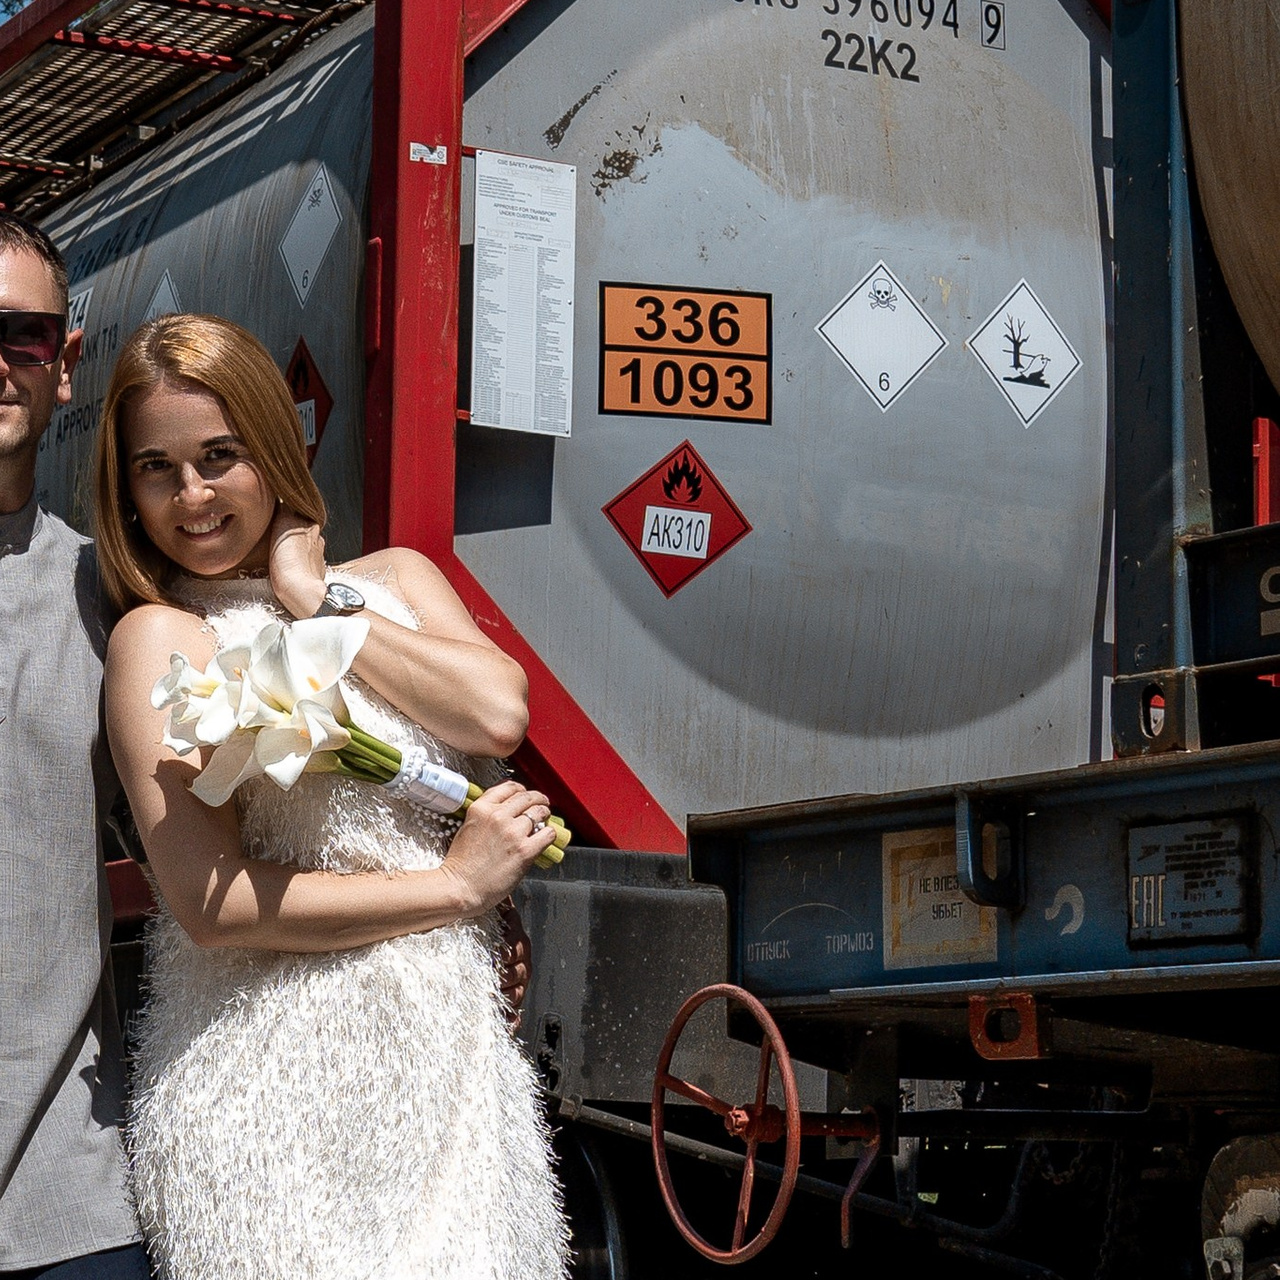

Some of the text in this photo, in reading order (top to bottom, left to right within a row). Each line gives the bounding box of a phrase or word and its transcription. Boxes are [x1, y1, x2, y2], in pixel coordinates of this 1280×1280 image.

[983, 4, 1002, 44] 9
[821, 29, 920, 83] 22K2
[302, 269, 309, 289] 6
[634, 295, 741, 346] 336
[619, 357, 754, 411] 1093
[878, 372, 890, 392] 6
[920, 875, 960, 895] НЕ ВЛЕЗ
[747, 932, 874, 962] ОТПУСК ТОРМОЗ
